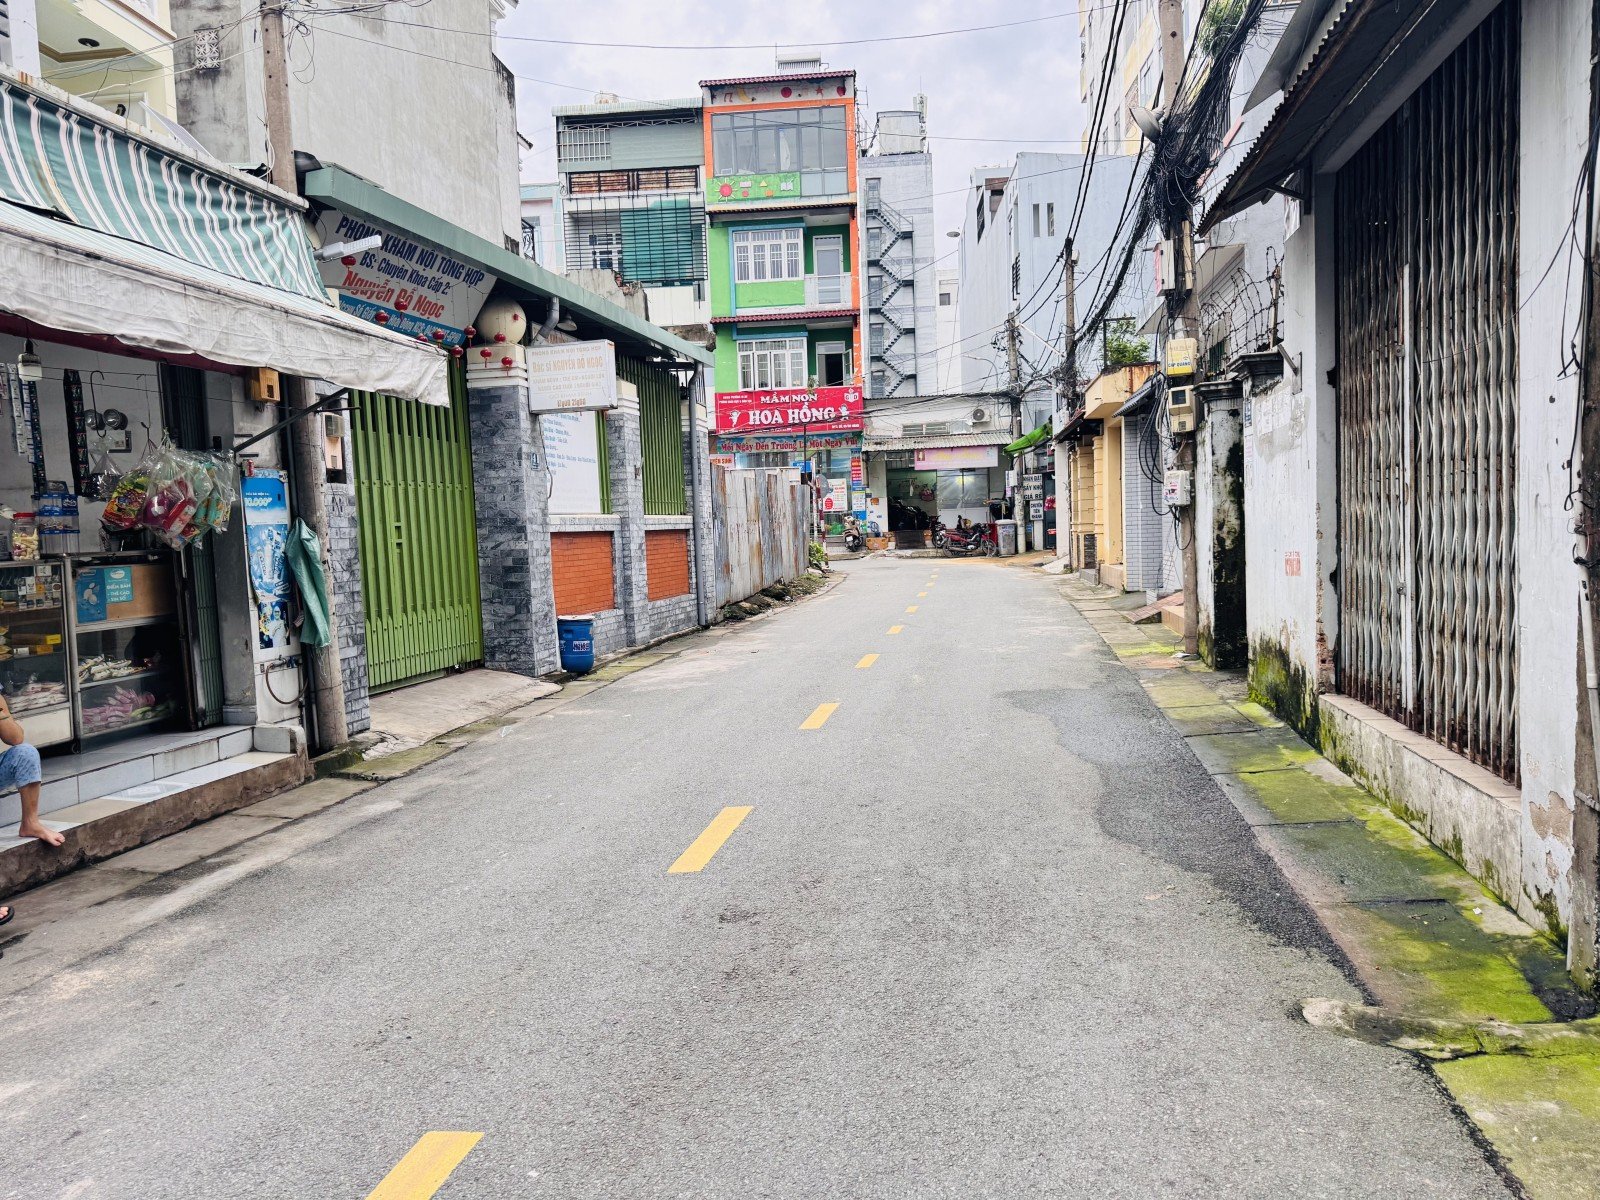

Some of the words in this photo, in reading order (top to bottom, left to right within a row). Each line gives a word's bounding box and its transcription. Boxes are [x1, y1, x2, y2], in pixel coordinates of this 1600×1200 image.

[380, 233, 418, 262] KHÁM
[415, 248, 438, 271] NỘI
[463, 266, 485, 288] HỢP
[377, 257, 407, 281] Chuyên
[407, 267, 429, 288] Khoa
[427, 275, 443, 295] Cấp
[412, 294, 445, 320] Ngọc
[760, 391, 790, 404] MẦM
[792, 393, 818, 402] NON
[749, 410, 783, 425] HOA
[787, 402, 836, 424] HỒNG
[755, 441, 769, 451] Đến
[770, 440, 797, 453] Trường
[809, 440, 823, 450] Một
